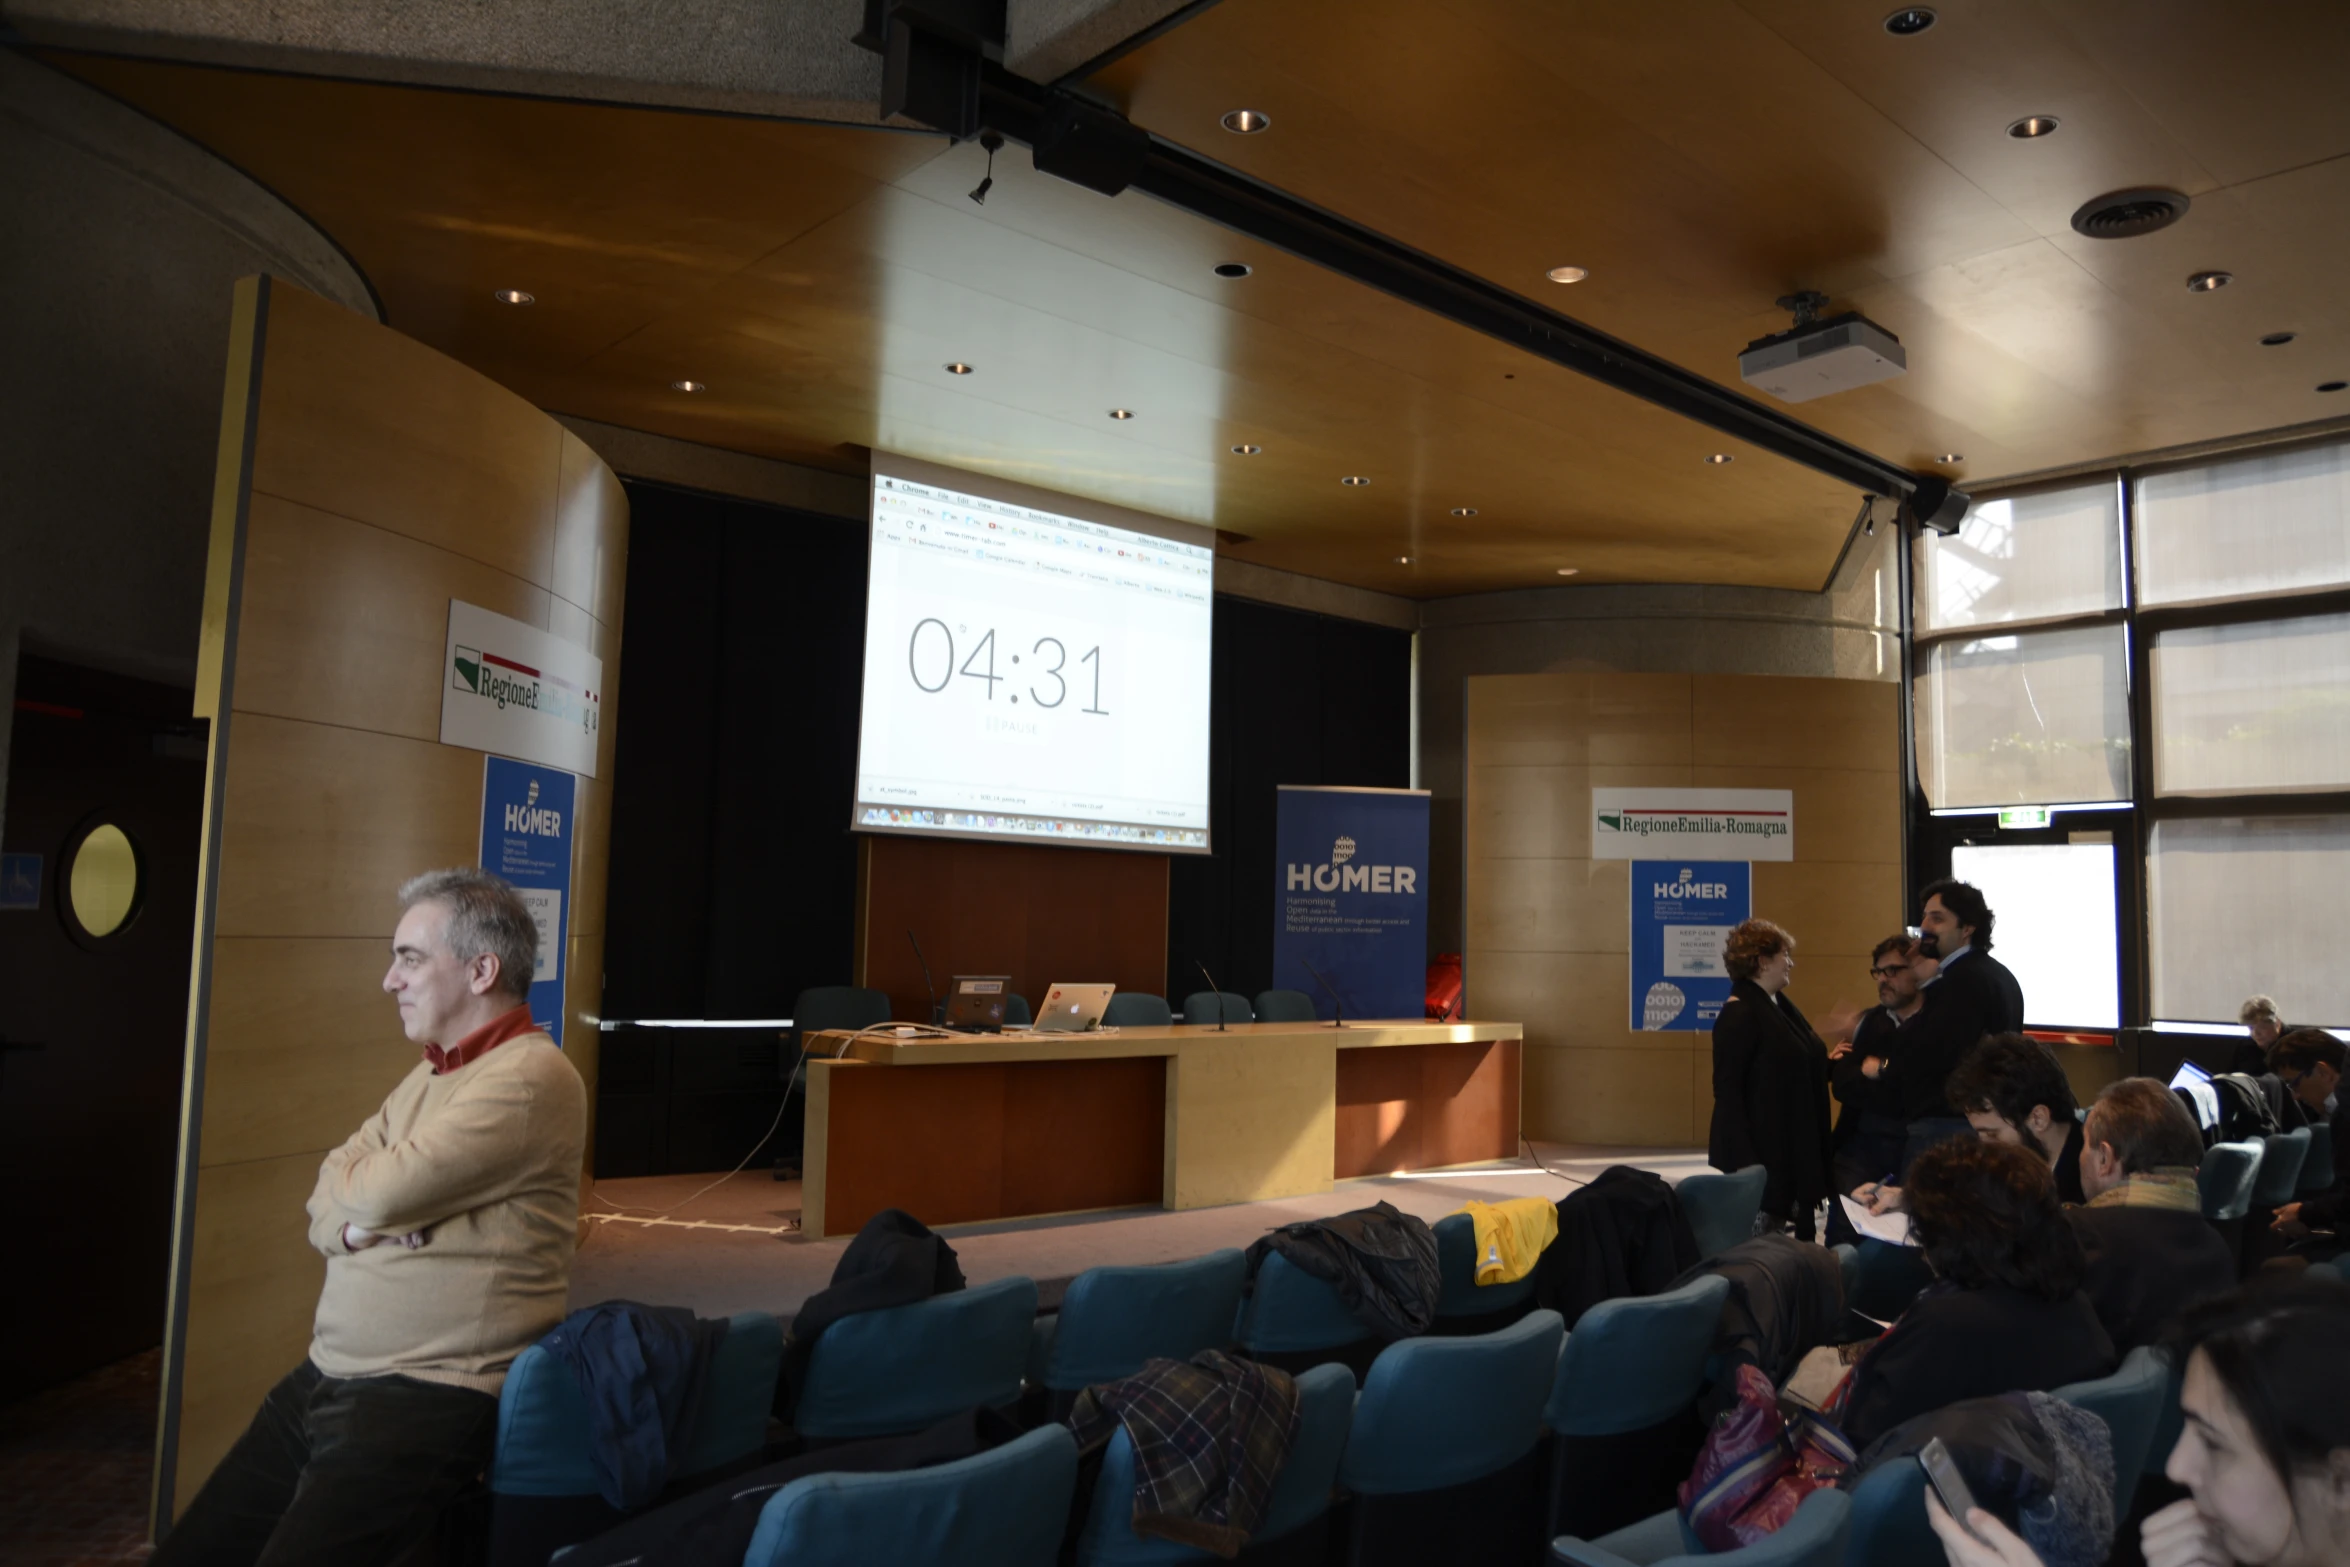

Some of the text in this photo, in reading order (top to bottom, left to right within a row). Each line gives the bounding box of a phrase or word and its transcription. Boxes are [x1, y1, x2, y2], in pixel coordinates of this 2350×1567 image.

[902, 483, 929, 496] Chrome
[938, 491, 949, 500] File
[957, 496, 969, 505] Edit
[978, 500, 992, 510] View
[1000, 506, 1021, 517] History
[1028, 512, 1060, 526] Bookmarks
[1067, 521, 1090, 532] Window
[1096, 527, 1109, 537] Help
[908, 618, 1109, 716] 04:31
[504, 804, 561, 838] HOMER
[1623, 816, 1788, 839] RegioneEmilia-Romagna
[1287, 863, 1416, 894] HOMER
[1654, 882, 1728, 899] HOMER
[1286, 897, 1336, 907] Harmonising
[1286, 906, 1308, 915] Open
[1286, 915, 1342, 924] Mediterranean
[1286, 924, 1310, 932] Reuse
